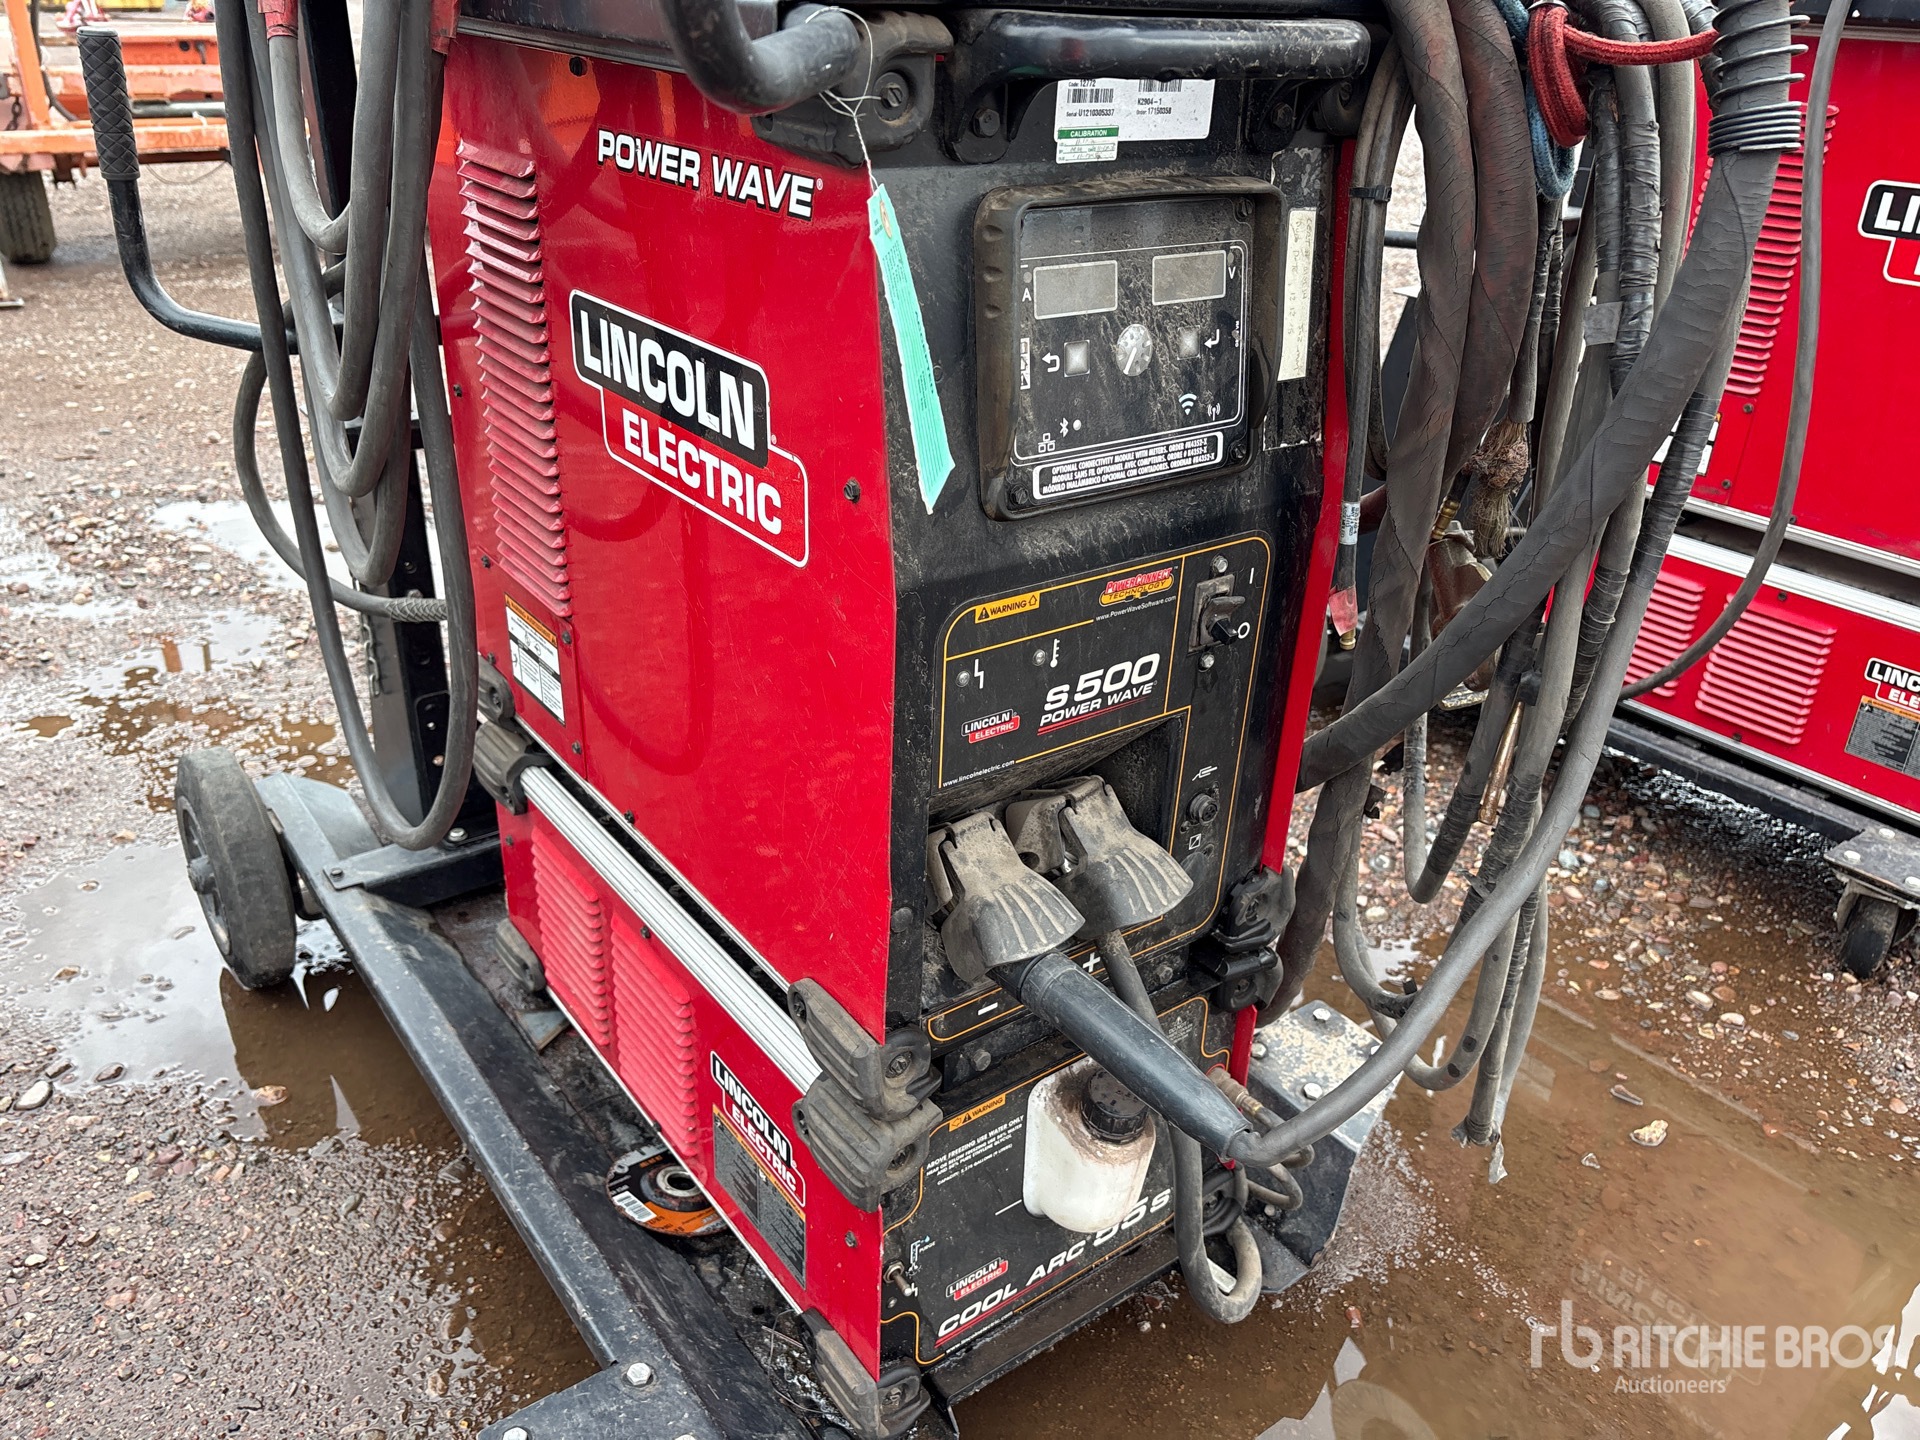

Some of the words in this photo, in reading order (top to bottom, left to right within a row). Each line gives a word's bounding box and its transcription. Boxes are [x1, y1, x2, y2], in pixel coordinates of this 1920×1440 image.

[1080, 79, 1096, 87] 12772
[1070, 129, 1108, 138] CALIBRATION
[598, 130, 700, 188] POWER
[1874, 191, 1920, 234] LI
[1228, 266, 1236, 279] V
[1022, 288, 1032, 302] A
[580, 310, 755, 450] LINCOLN
[622, 407, 782, 535] ELECTRIC
[1052, 462, 1078, 475] OPTIONAL
[1078, 456, 1114, 470] CONNECTIVITY
[1114, 452, 1134, 463] MODULE
[1134, 448, 1148, 459] WITH
[1168, 442, 1184, 452] ORDER
[1052, 472, 1074, 484] MODULE
[1074, 470, 1088, 480] SANS
[1088, 468, 1096, 477] FIL
[1096, 463, 1124, 475] OPTIONNEL
[1124, 460, 1136, 470] AVEC
[1167, 451, 1182, 460] ORDRE
[1043, 481, 1066, 494] MÓDULO
[1102, 472, 1126, 482] OPCIONAL
[1126, 469, 1138, 478] CON
[1170, 458, 1192, 468] ORDENAR
[1108, 580, 1166, 600] TECHNOLOGY
[989, 600, 1028, 616] WARNING
[1096, 595, 1177, 622] www.PowerWaveSoftware.com
[1040, 699, 1102, 728] POWER
[1107, 681, 1155, 706] WAVE
[964, 711, 1010, 736] LINCOLN
[974, 721, 1015, 741] ELECTRIC
[942, 759, 1015, 788] www.lincolnelectric.com
[714, 1060, 789, 1162] LINCOLN
[972, 1097, 1004, 1118] WARNING
[732, 1106, 796, 1192] ELECTRIC
[926, 1154, 947, 1170] ABOVE
[948, 1140, 976, 1159] FREEZING
[976, 1134, 988, 1144] USE
[988, 1124, 1008, 1138] WATER
[1008, 1114, 1024, 1127] ONLY
[948, 1154, 964, 1165] BELOW
[965, 1142, 986, 1156] FREEZING
[987, 1137, 996, 1145] USE
[1008, 1124, 1022, 1134] WATER
[936, 1167, 948, 1176] AND
[960, 1155, 972, 1164] PURE
[919, 1240, 936, 1254] PURGE
[938, 1283, 1018, 1338] COOL
[1026, 1240, 1086, 1286] ARC
[950, 1261, 998, 1296] LINCOLN
[960, 1267, 1003, 1297] ELECTRIC
